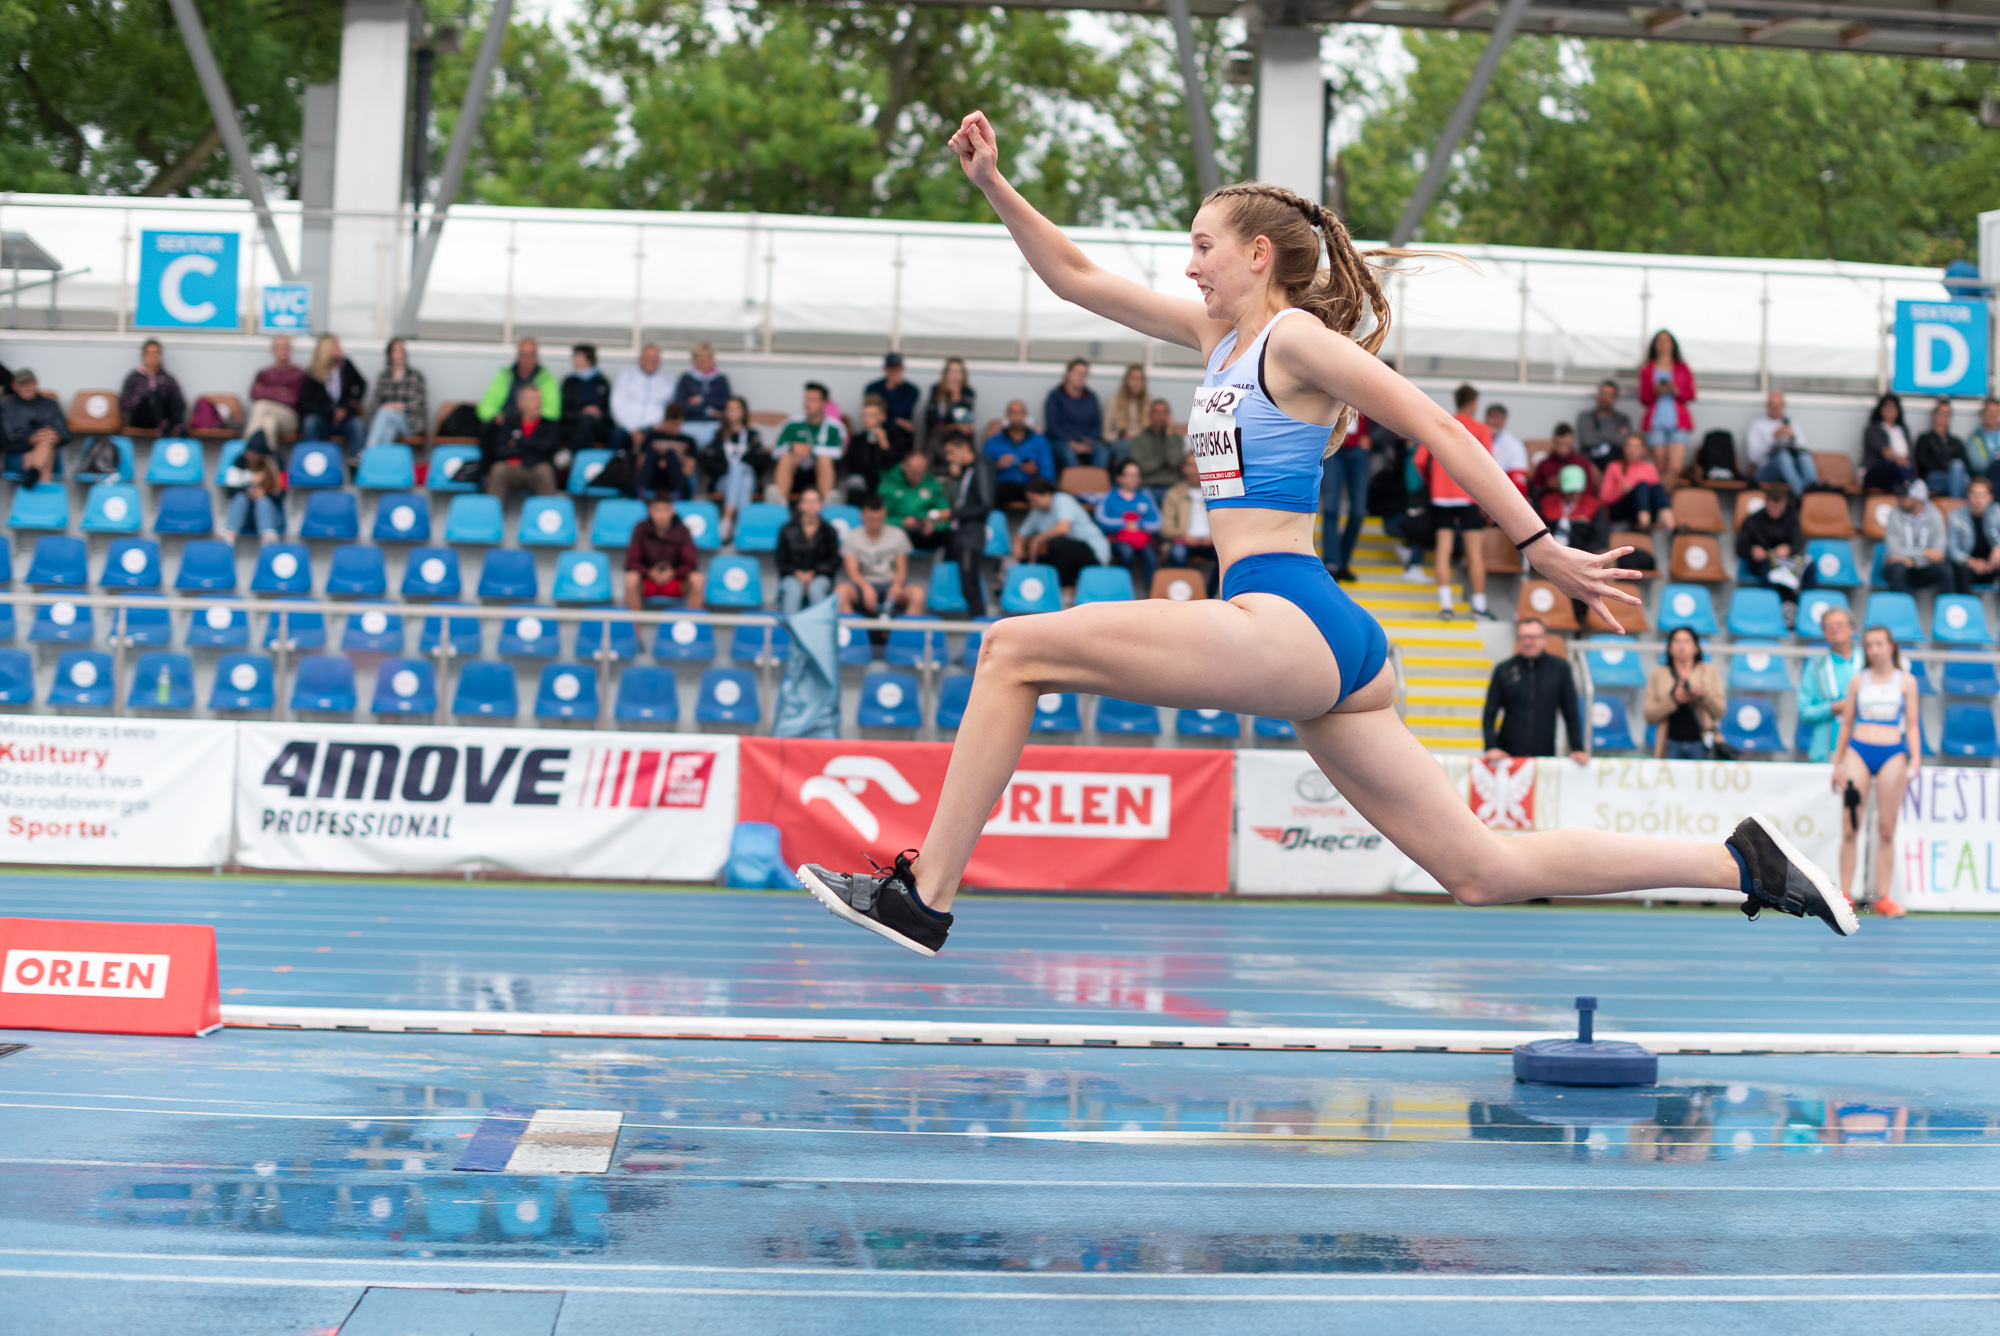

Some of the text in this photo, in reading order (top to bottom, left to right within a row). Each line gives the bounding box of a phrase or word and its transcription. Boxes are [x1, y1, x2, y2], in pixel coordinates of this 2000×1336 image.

[156, 234, 224, 253] SEKTOR
[159, 253, 218, 324] C
[265, 290, 308, 314] WC
[1910, 303, 1971, 323] SEKTOR
[1913, 322, 1970, 388] D
[1205, 390, 1236, 414] 642
[0, 720, 157, 740] Ministerstwo
[0, 742, 110, 770] Kultury
[0, 769, 144, 788] Dziedzictwa
[262, 741, 571, 806] 4MOVE
[1596, 759, 1751, 792] PZLA 100
[261, 809, 453, 840] PROFESSIONAL
[1291, 805, 1348, 819] TOYOTA
[1595, 802, 1719, 835] Spółka
[8, 815, 119, 841] Sportu.
[15, 958, 156, 990] ORLEN
